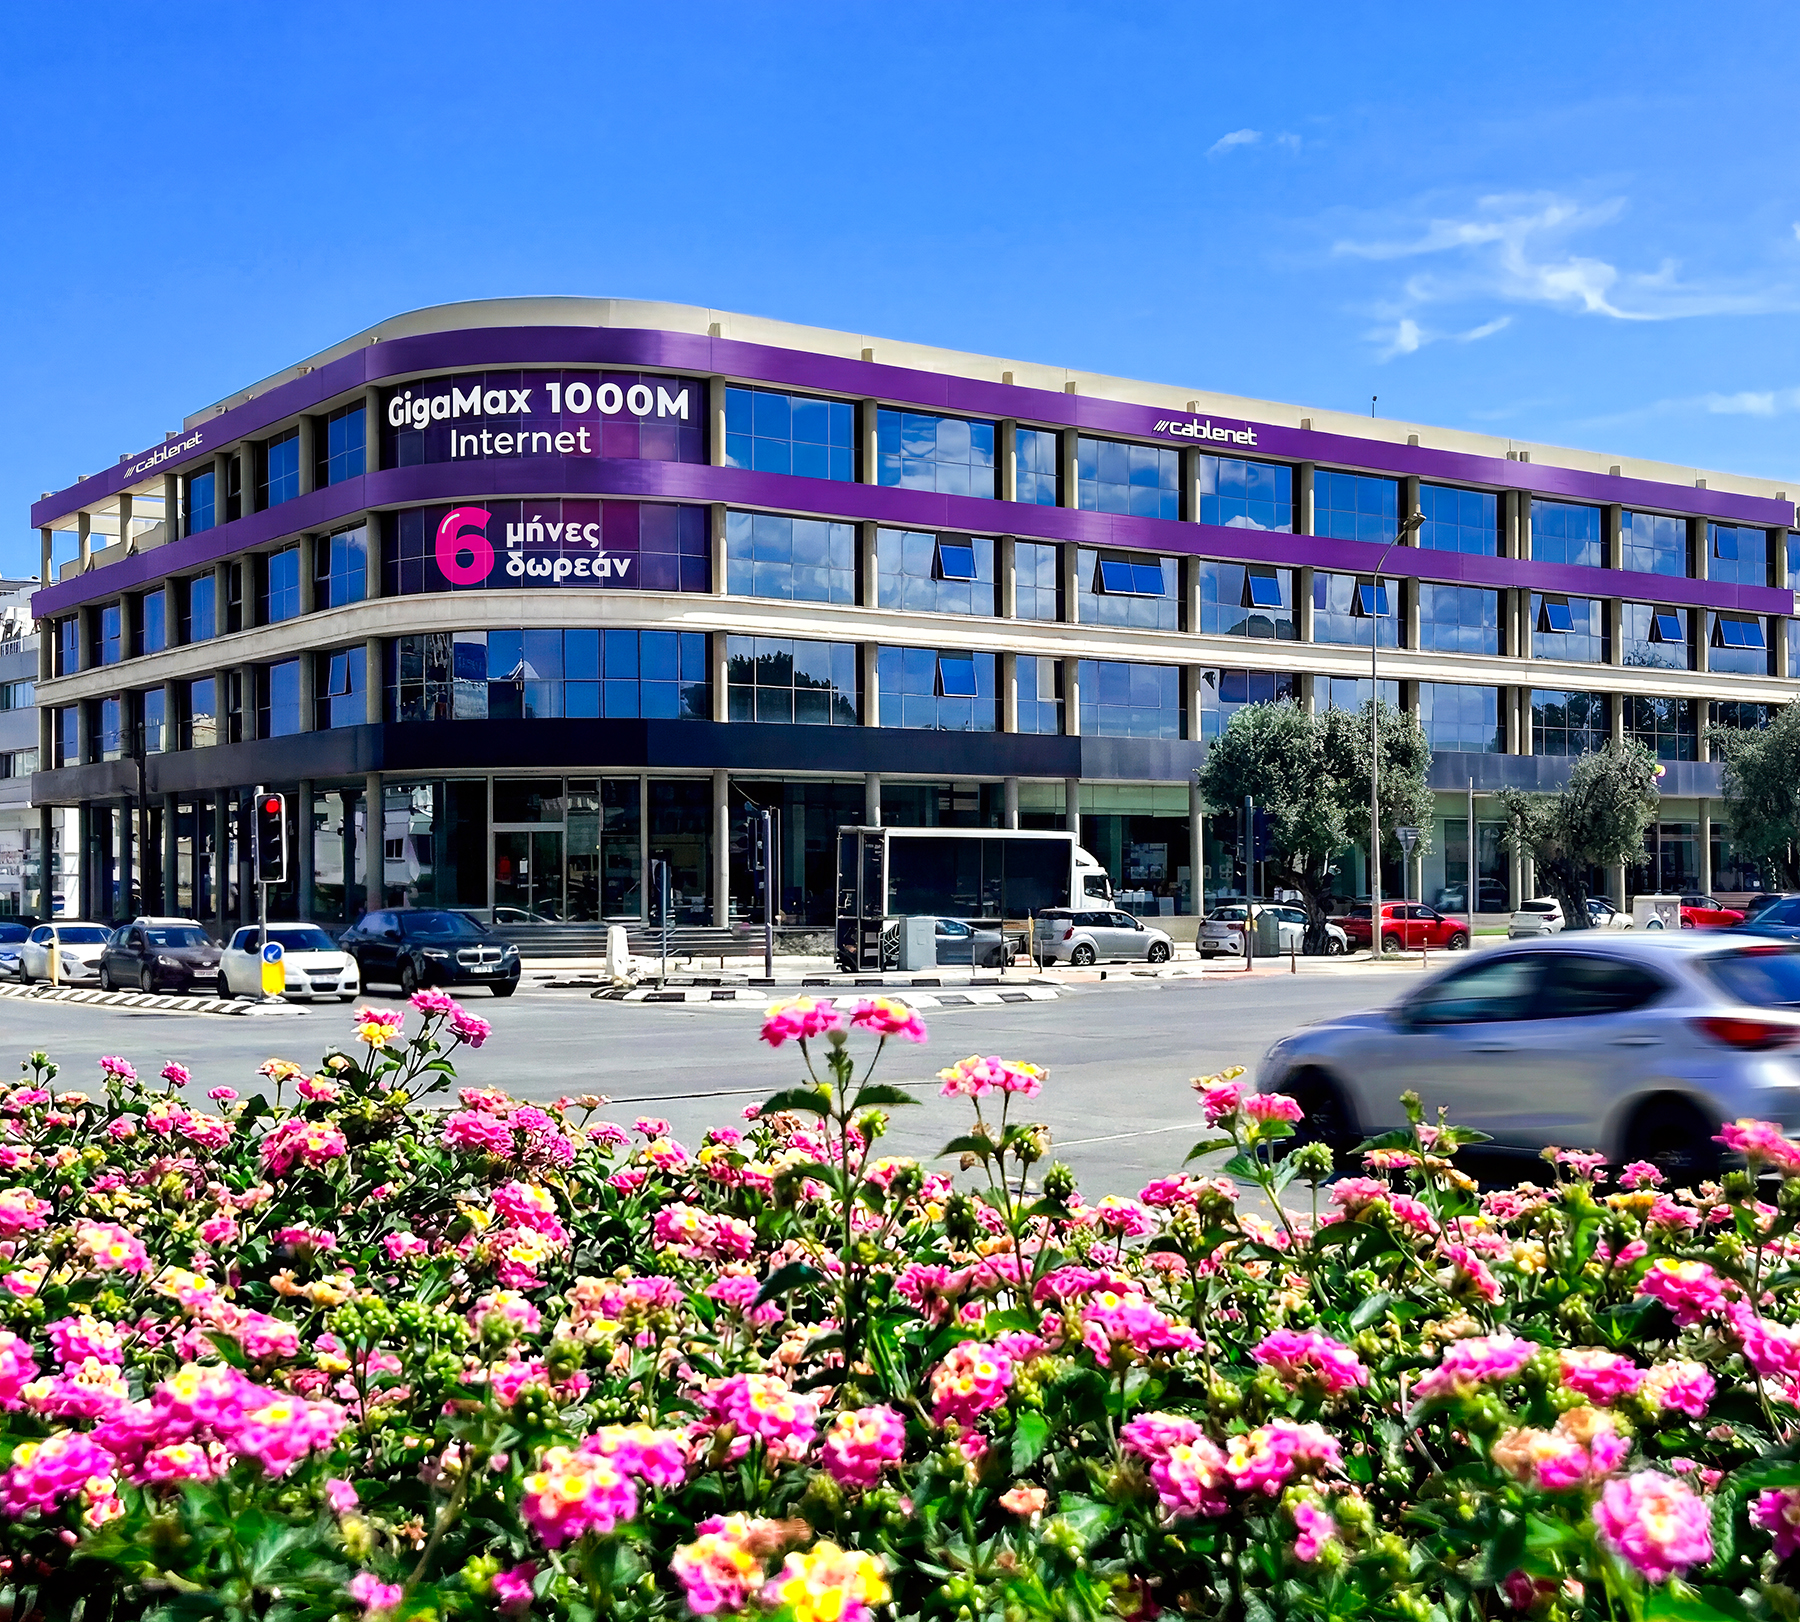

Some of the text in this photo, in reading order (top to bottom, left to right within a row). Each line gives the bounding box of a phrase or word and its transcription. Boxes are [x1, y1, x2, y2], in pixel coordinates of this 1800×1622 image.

[388, 382, 690, 429] GigaMax 1000M
[451, 426, 592, 458] Internet
[1169, 418, 1258, 445] cablenet
[135, 431, 203, 474] cablenet
[435, 506, 600, 585] 6 μήνες
[505, 550, 632, 583] δωρεάν
